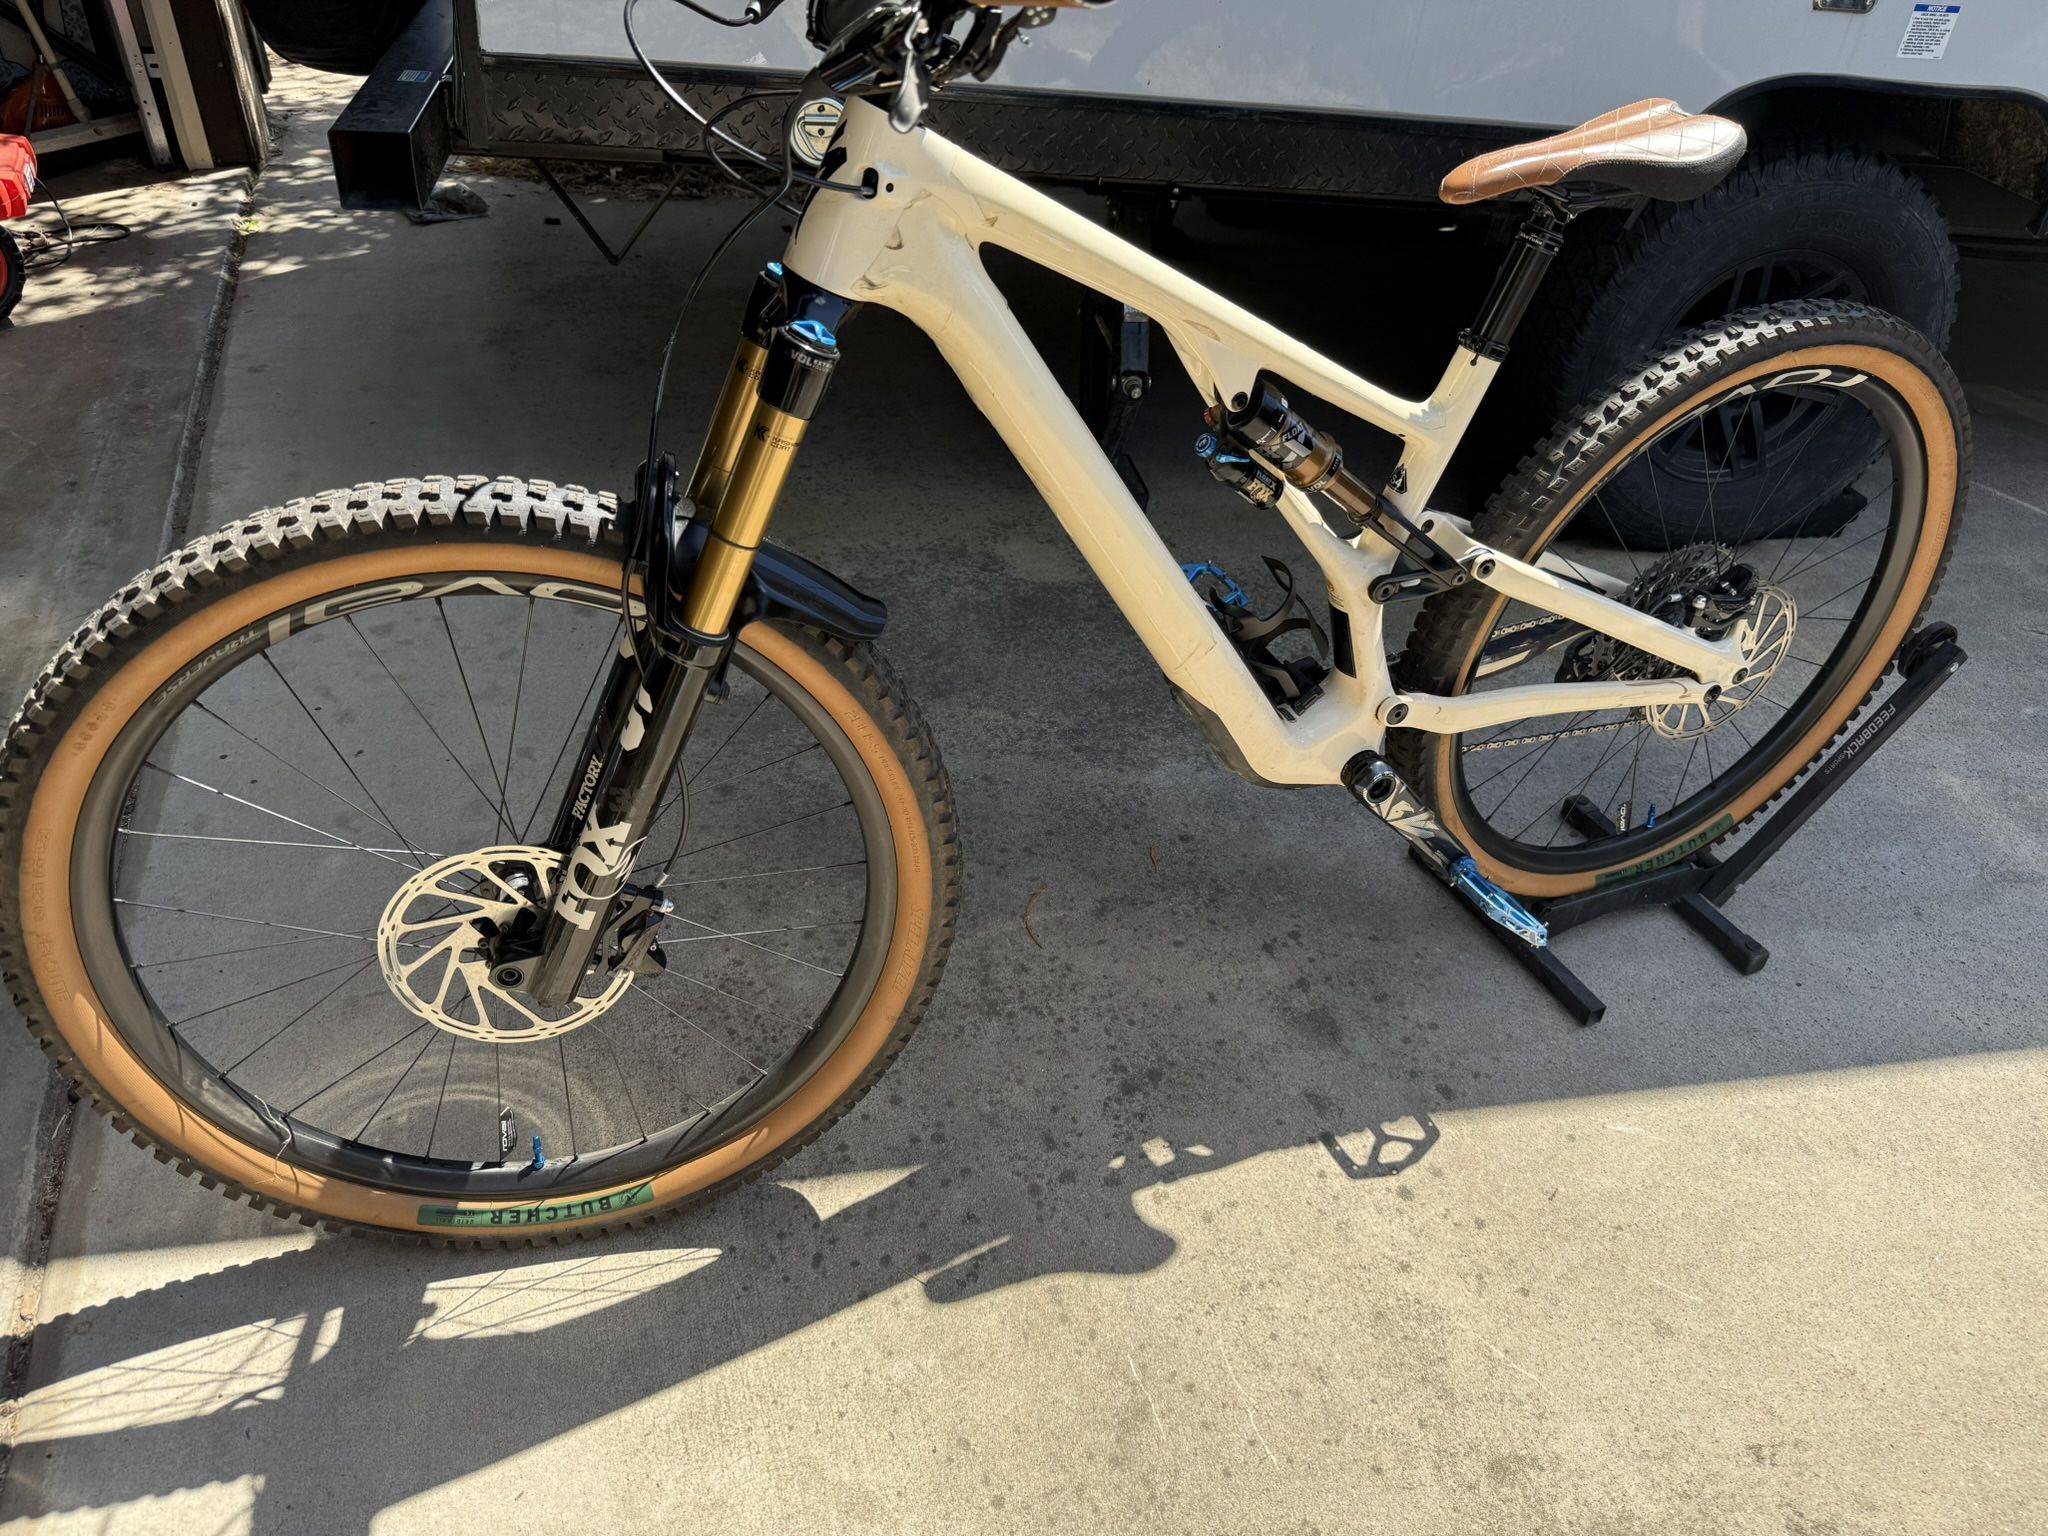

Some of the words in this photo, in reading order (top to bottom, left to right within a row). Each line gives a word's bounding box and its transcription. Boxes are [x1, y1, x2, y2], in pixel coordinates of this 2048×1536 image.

[1247, 477, 1275, 503] FOX
[1843, 703, 1896, 760] FEEDBACK
[571, 753, 603, 821] FACTORY
[553, 800, 648, 931] FOX
[1635, 833, 1709, 873] BUTCHER
[500, 1120, 508, 1152] roval
[490, 1197, 615, 1225] BUTCHER
